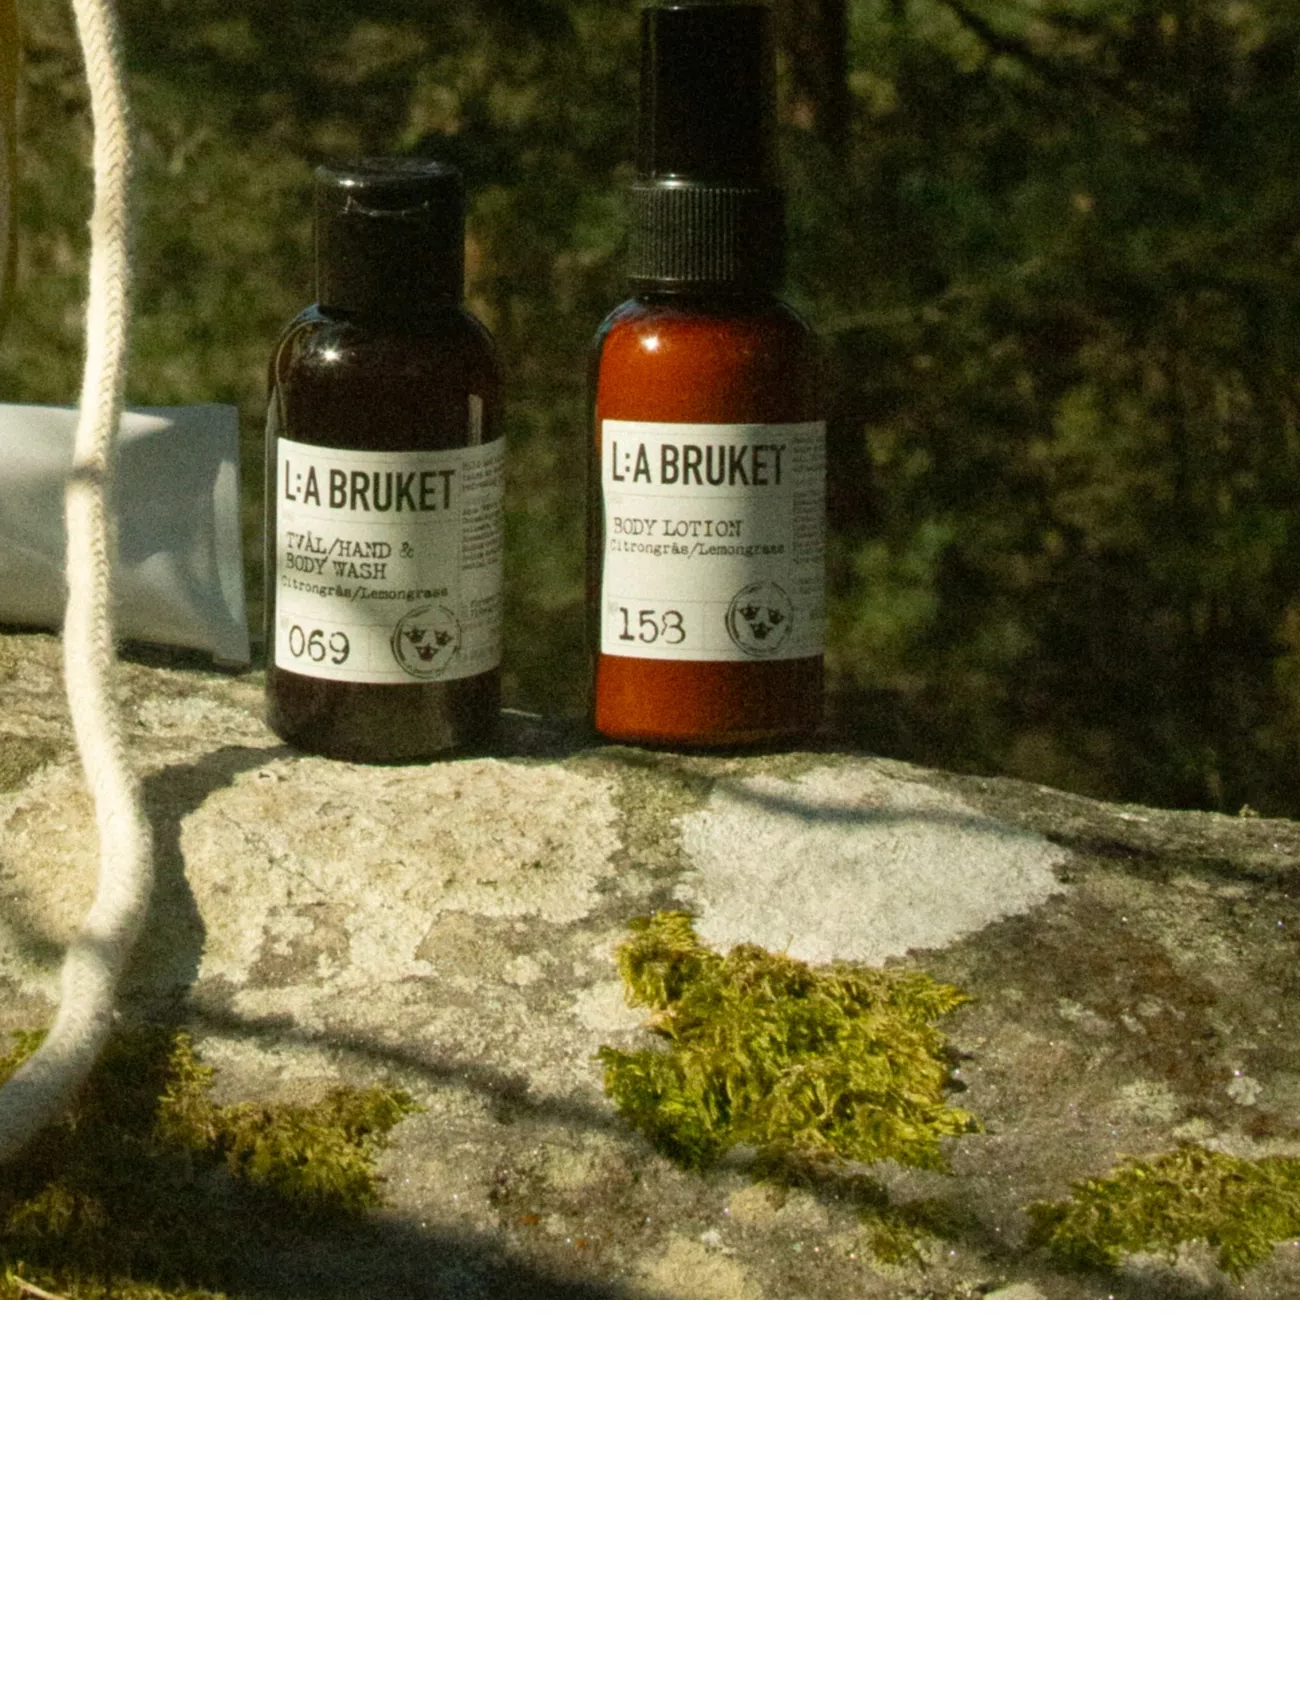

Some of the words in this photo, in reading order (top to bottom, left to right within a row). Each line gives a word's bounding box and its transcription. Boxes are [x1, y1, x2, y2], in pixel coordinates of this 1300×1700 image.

[612, 441, 652, 483] L:A
[661, 443, 787, 486] BRUKET
[285, 459, 321, 506] L:A
[329, 469, 455, 512] BRUKET
[613, 517, 657, 536] BODY
[663, 520, 743, 537] LOTION
[286, 531, 392, 559] TVÅL/HAND
[399, 542, 414, 559] &
[286, 553, 329, 575] BODY
[332, 561, 388, 580] WASH
[289, 625, 350, 665] 069
